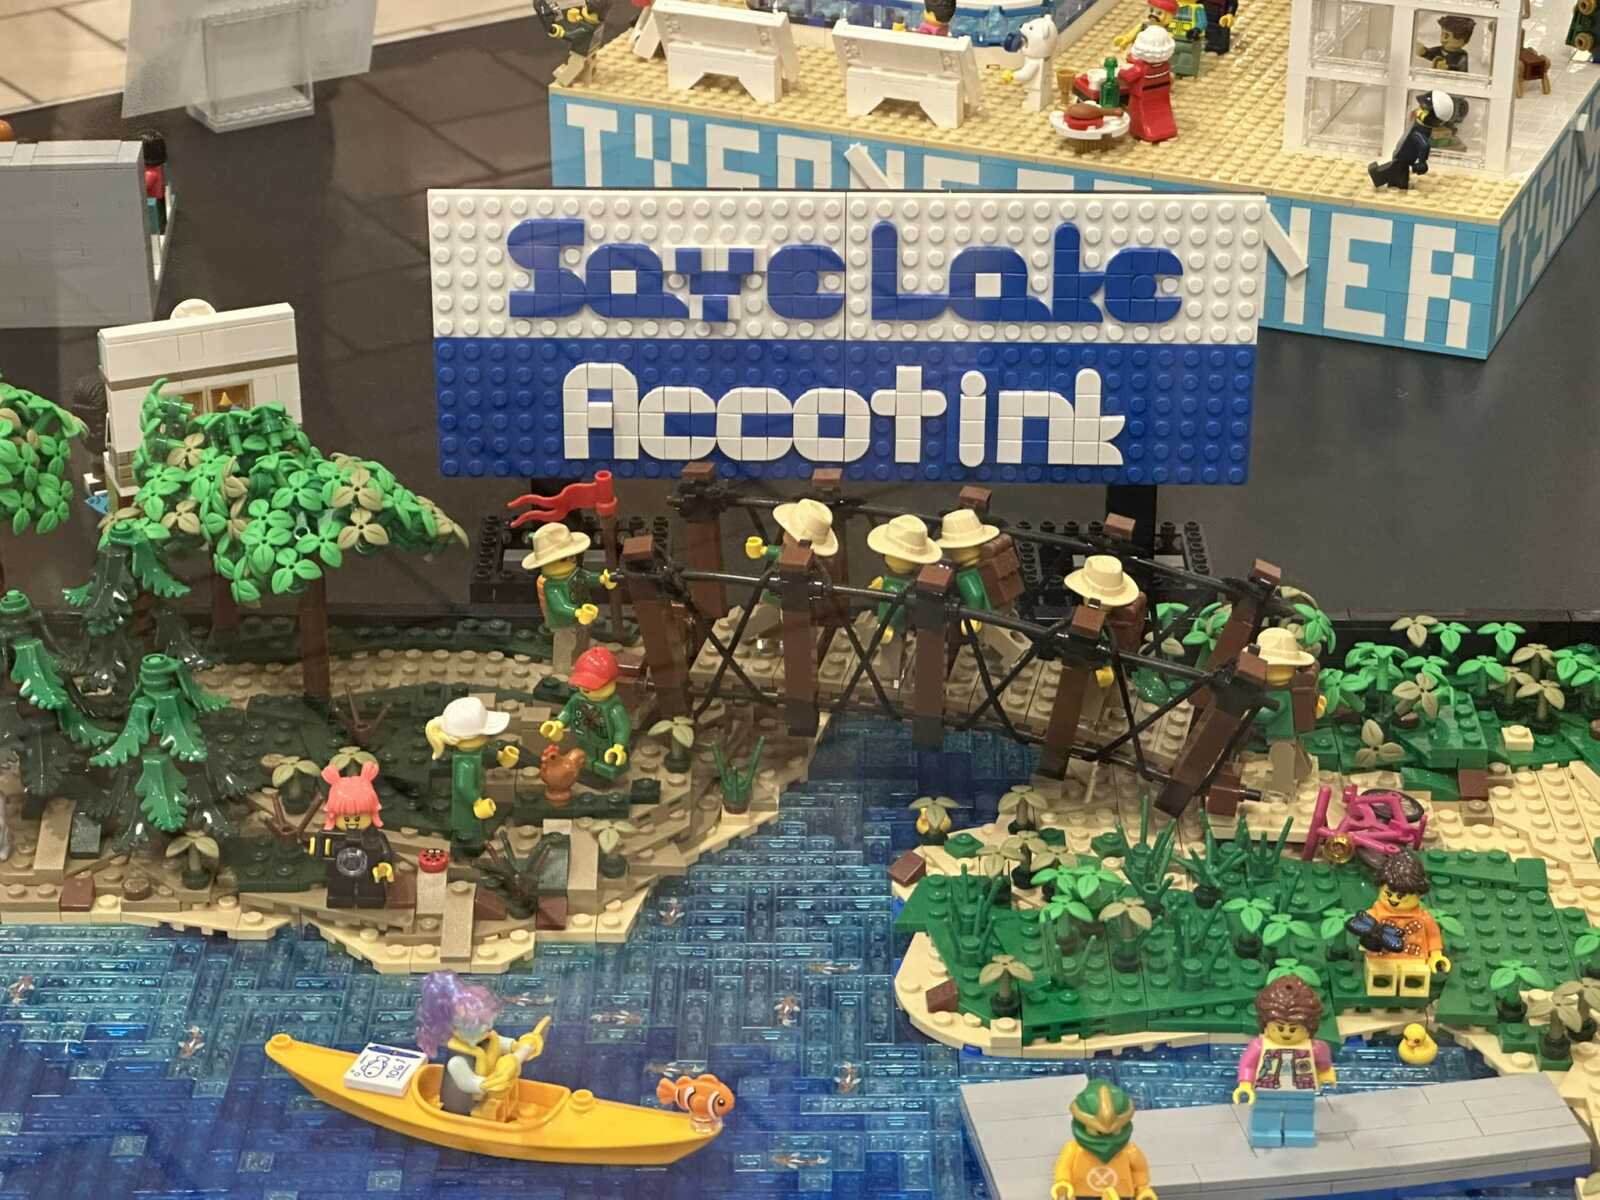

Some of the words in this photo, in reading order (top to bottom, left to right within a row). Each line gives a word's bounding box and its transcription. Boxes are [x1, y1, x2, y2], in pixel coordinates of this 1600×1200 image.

[506, 218, 845, 322] Save
[871, 220, 1184, 322] Lake
[563, 362, 1126, 467] Accotink
